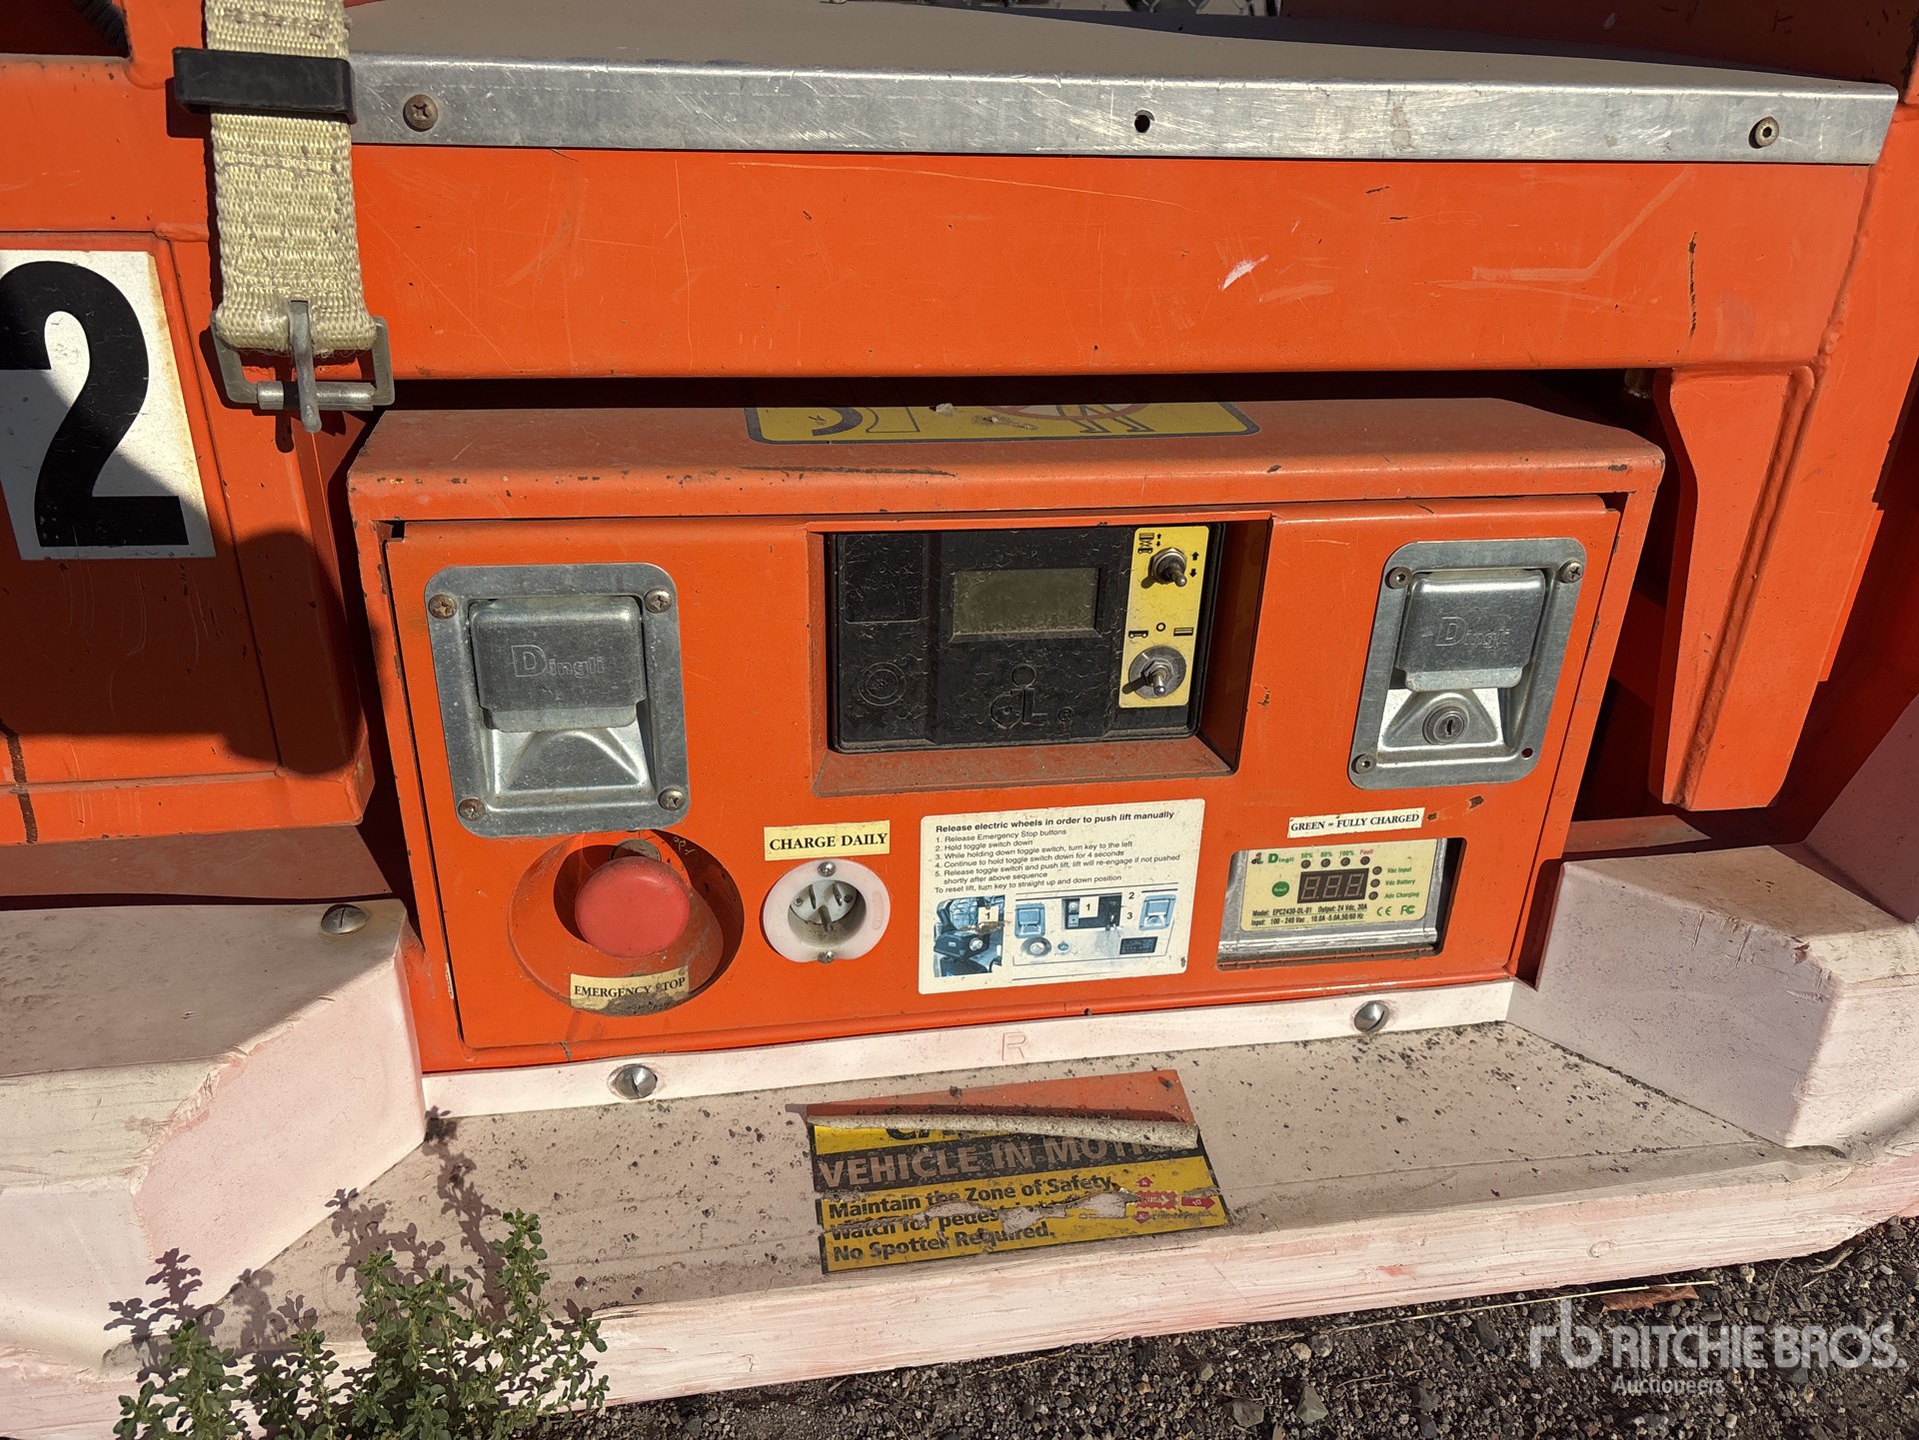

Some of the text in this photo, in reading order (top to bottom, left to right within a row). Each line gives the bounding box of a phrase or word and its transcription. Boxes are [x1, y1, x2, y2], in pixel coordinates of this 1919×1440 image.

[0, 261, 189, 547] 2
[1436, 616, 1511, 649] Dingli
[510, 644, 605, 678] Dingli
[936, 825, 972, 833] Release
[975, 822, 1008, 830] electric
[1011, 818, 1042, 828] wheels
[1045, 818, 1054, 826] in
[1083, 816, 1092, 824] to
[1094, 815, 1117, 824] push
[1134, 811, 1174, 820] manually
[1291, 820, 1325, 831] GREEN
[1336, 817, 1368, 828] FULLY
[1370, 813, 1420, 825] CHARGED
[769, 833, 888, 851] CHARGE DAILY
[977, 832, 1018, 840] Emergency
[1021, 830, 1038, 838] Stop
[1040, 828, 1066, 836] buttons
[944, 852, 965, 860] While
[966, 850, 994, 860] holding
[1017, 847, 1040, 856] toggle
[964, 842, 986, 851] toggle
[944, 860, 978, 868] Continue
[1006, 856, 1028, 866] toggle
[1030, 854, 1052, 862] switch
[1054, 852, 1074, 860] down
[1094, 850, 1124, 858] seconds
[944, 868, 974, 876] Release
[976, 866, 999, 876] toggle
[1041, 864, 1058, 872] push
[1096, 858, 1132, 866] re-engage
[1154, 854, 1180, 863] pushed
[1268, 853, 1294, 863] Dingli
[944, 878, 968, 886] shortly
[988, 874, 1010, 882] above
[1012, 872, 1048, 880] sequence
[966, 884, 976, 892] lift,
[994, 882, 1007, 890] key
[1018, 879, 1044, 888] straight
[1128, 892, 1135, 900] 2
[985, 912, 991, 920] 1
[1086, 903, 1091, 911] 1
[1317, 905, 1336, 913] Output:
[1337, 904, 1344, 912] 24
[574, 985, 652, 998] EMERGENCY
[1001, 1031, 1029, 1061] R
[818, 1146, 981, 1188] VEHICLE
[990, 1140, 1034, 1170] IN
[829, 1195, 921, 1219] Maintain
[927, 1190, 961, 1204] the
[964, 1185, 1016, 1202] Zone
[1021, 1179, 1042, 1196] of
[833, 1246, 863, 1262] No
[869, 1237, 949, 1260] Spotter
